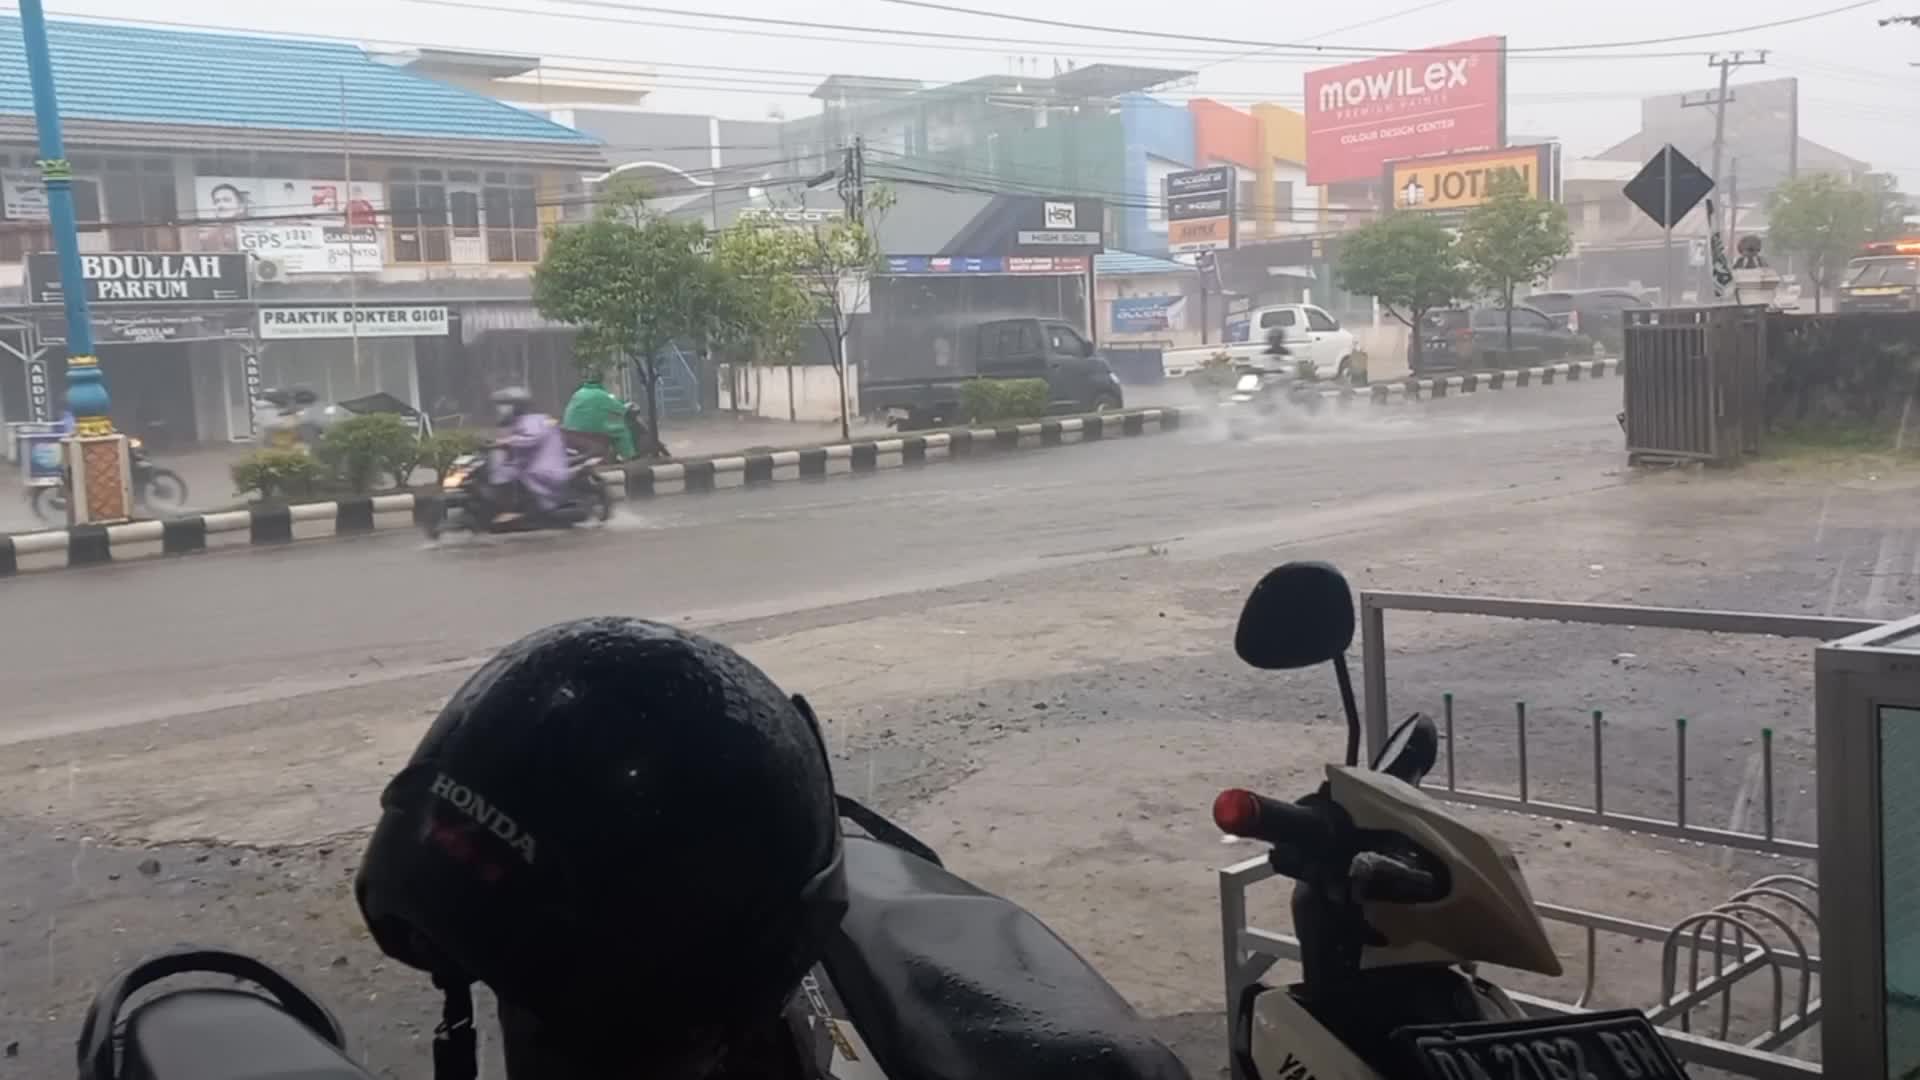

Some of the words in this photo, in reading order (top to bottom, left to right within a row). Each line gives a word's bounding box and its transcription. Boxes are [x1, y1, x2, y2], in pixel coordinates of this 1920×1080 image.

[1340, 130, 1379, 144] COLOUR
[1379, 124, 1416, 138] DESIGN
[1416, 118, 1456, 133] CENTER
[1429, 164, 1530, 202] JOTN
[241, 231, 281, 249] GPS
[1032, 233, 1059, 242] HIGH
[81, 256, 222, 280] BDULLAH
[97, 281, 189, 299] PARFUM
[263, 311, 338, 325] PRAKTIK
[344, 310, 407, 323] DOKTER
[411, 309, 445, 322] GIGI
[429, 772, 536, 864] HONDA
